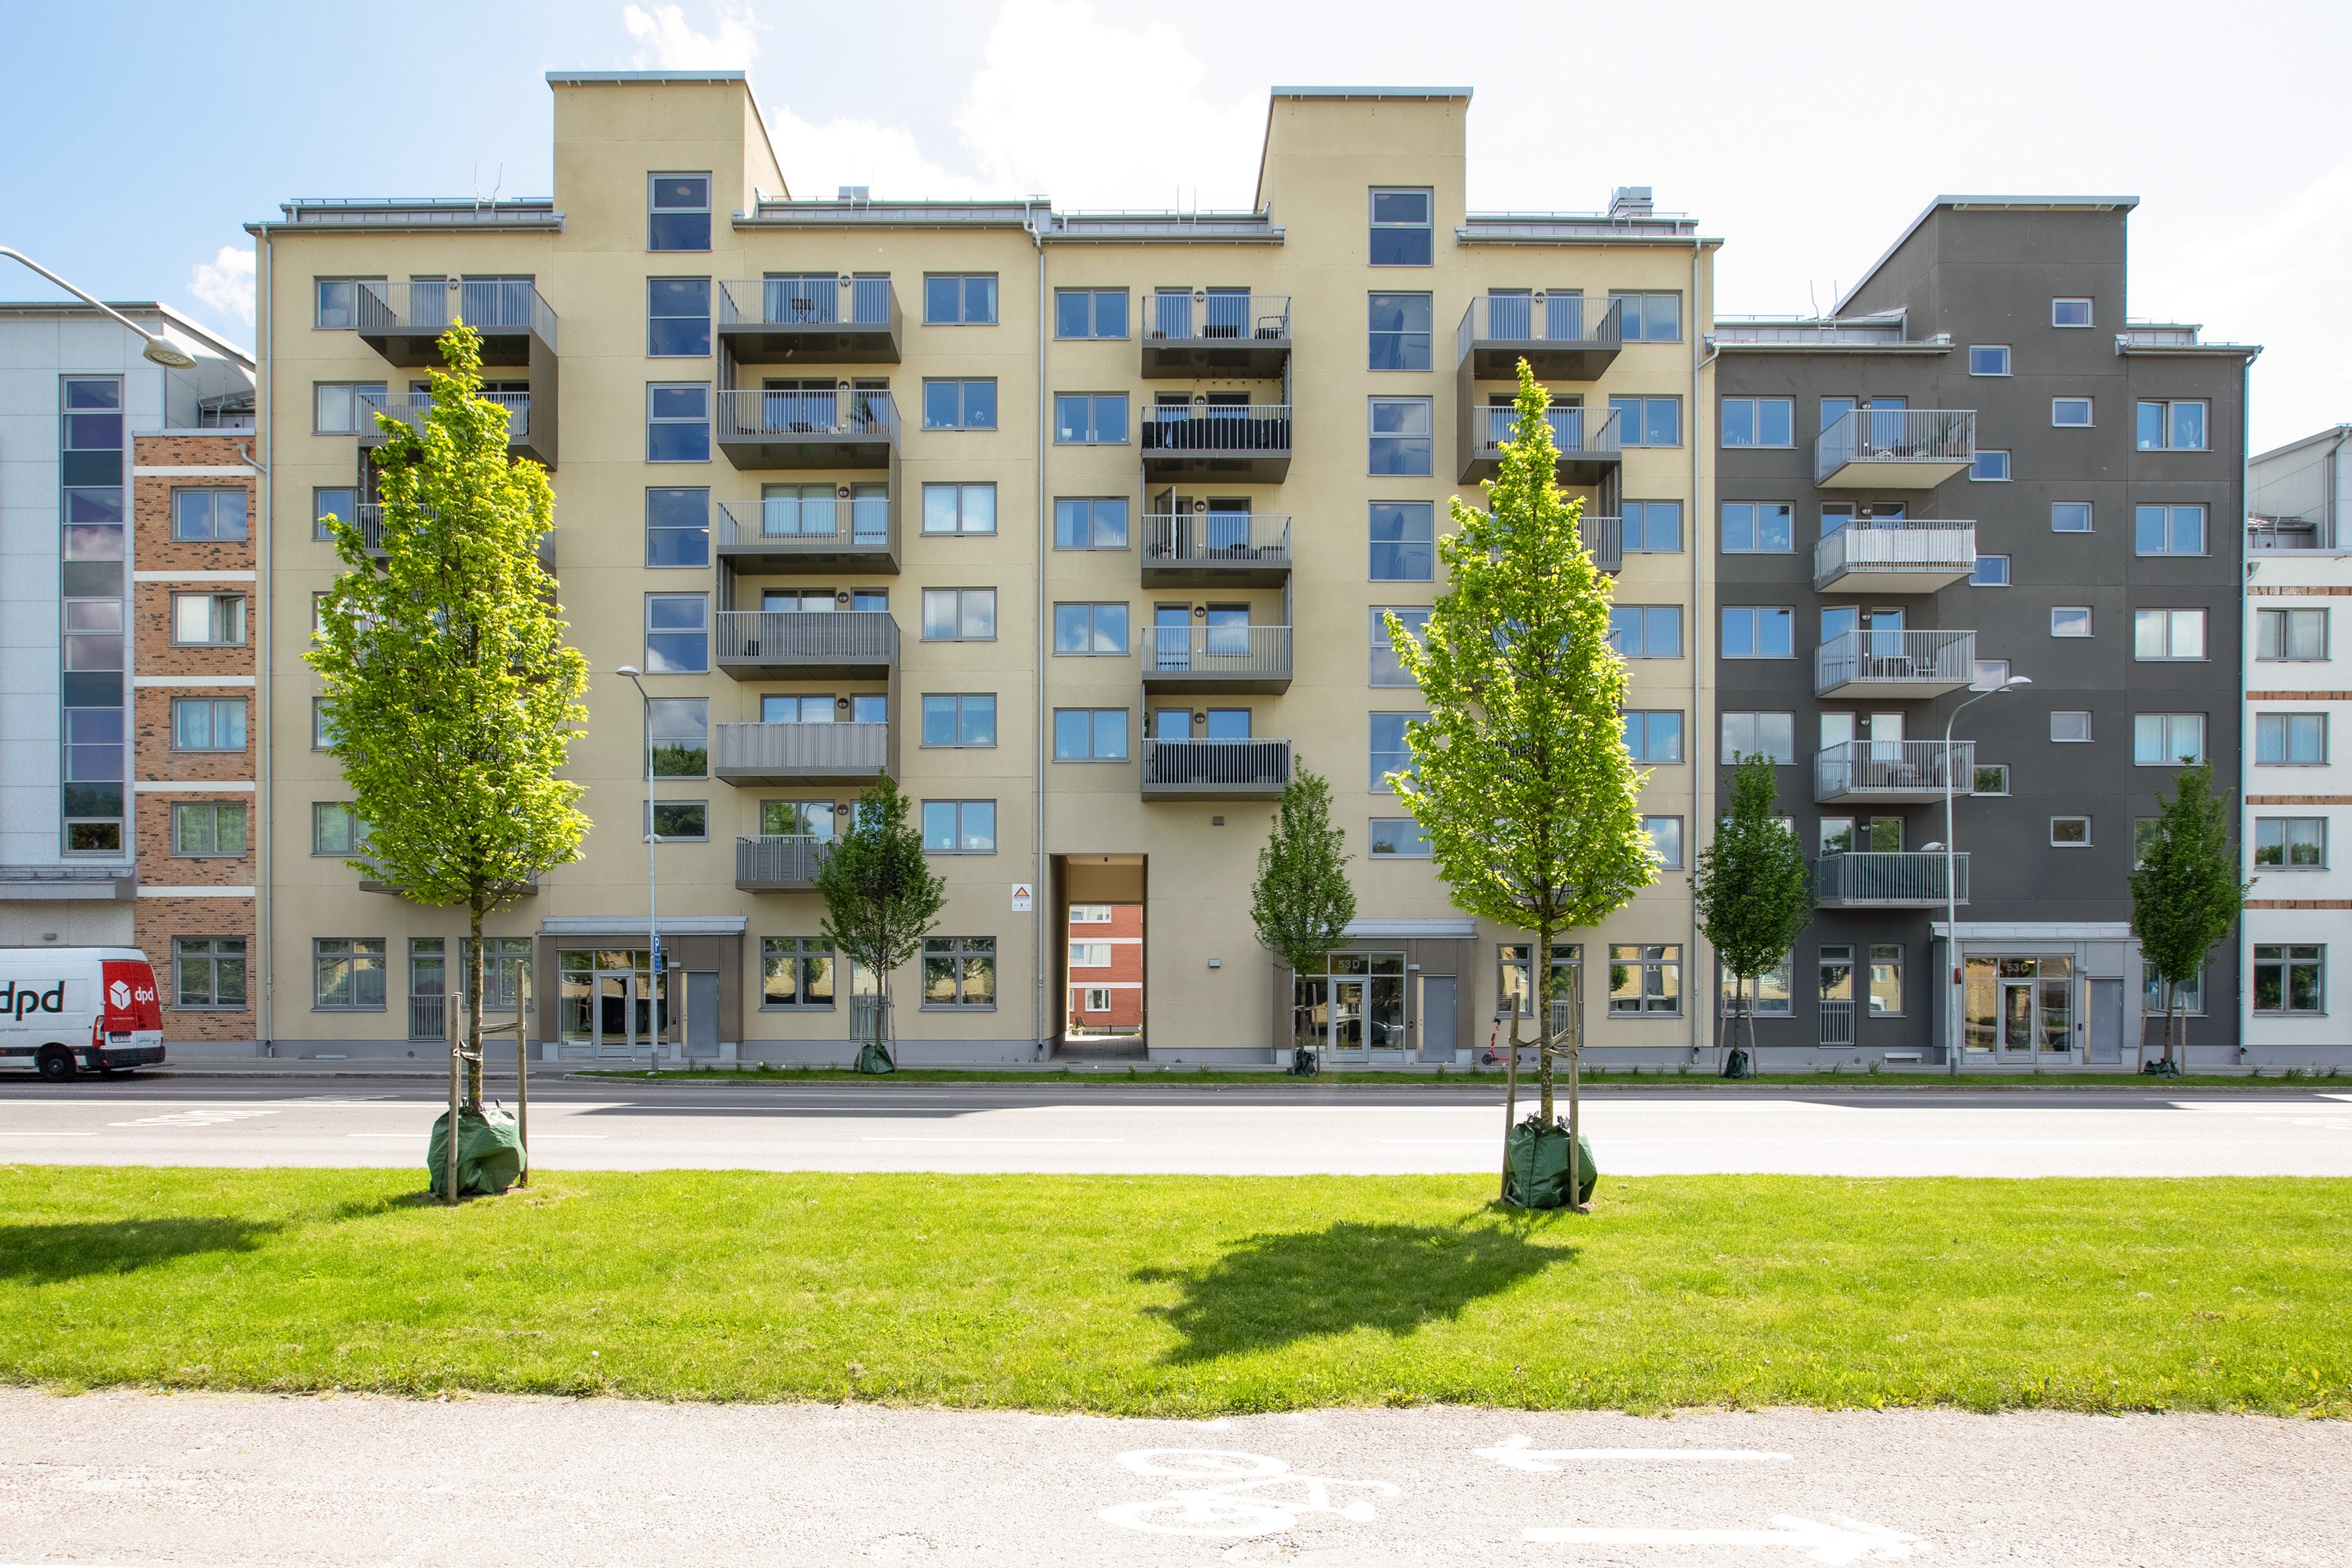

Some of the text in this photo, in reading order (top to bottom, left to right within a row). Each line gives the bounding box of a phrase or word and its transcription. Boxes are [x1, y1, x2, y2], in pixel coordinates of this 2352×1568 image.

[655, 936, 660, 952] P
[0, 981, 65, 1021] dpd
[134, 986, 154, 1005] dpd
